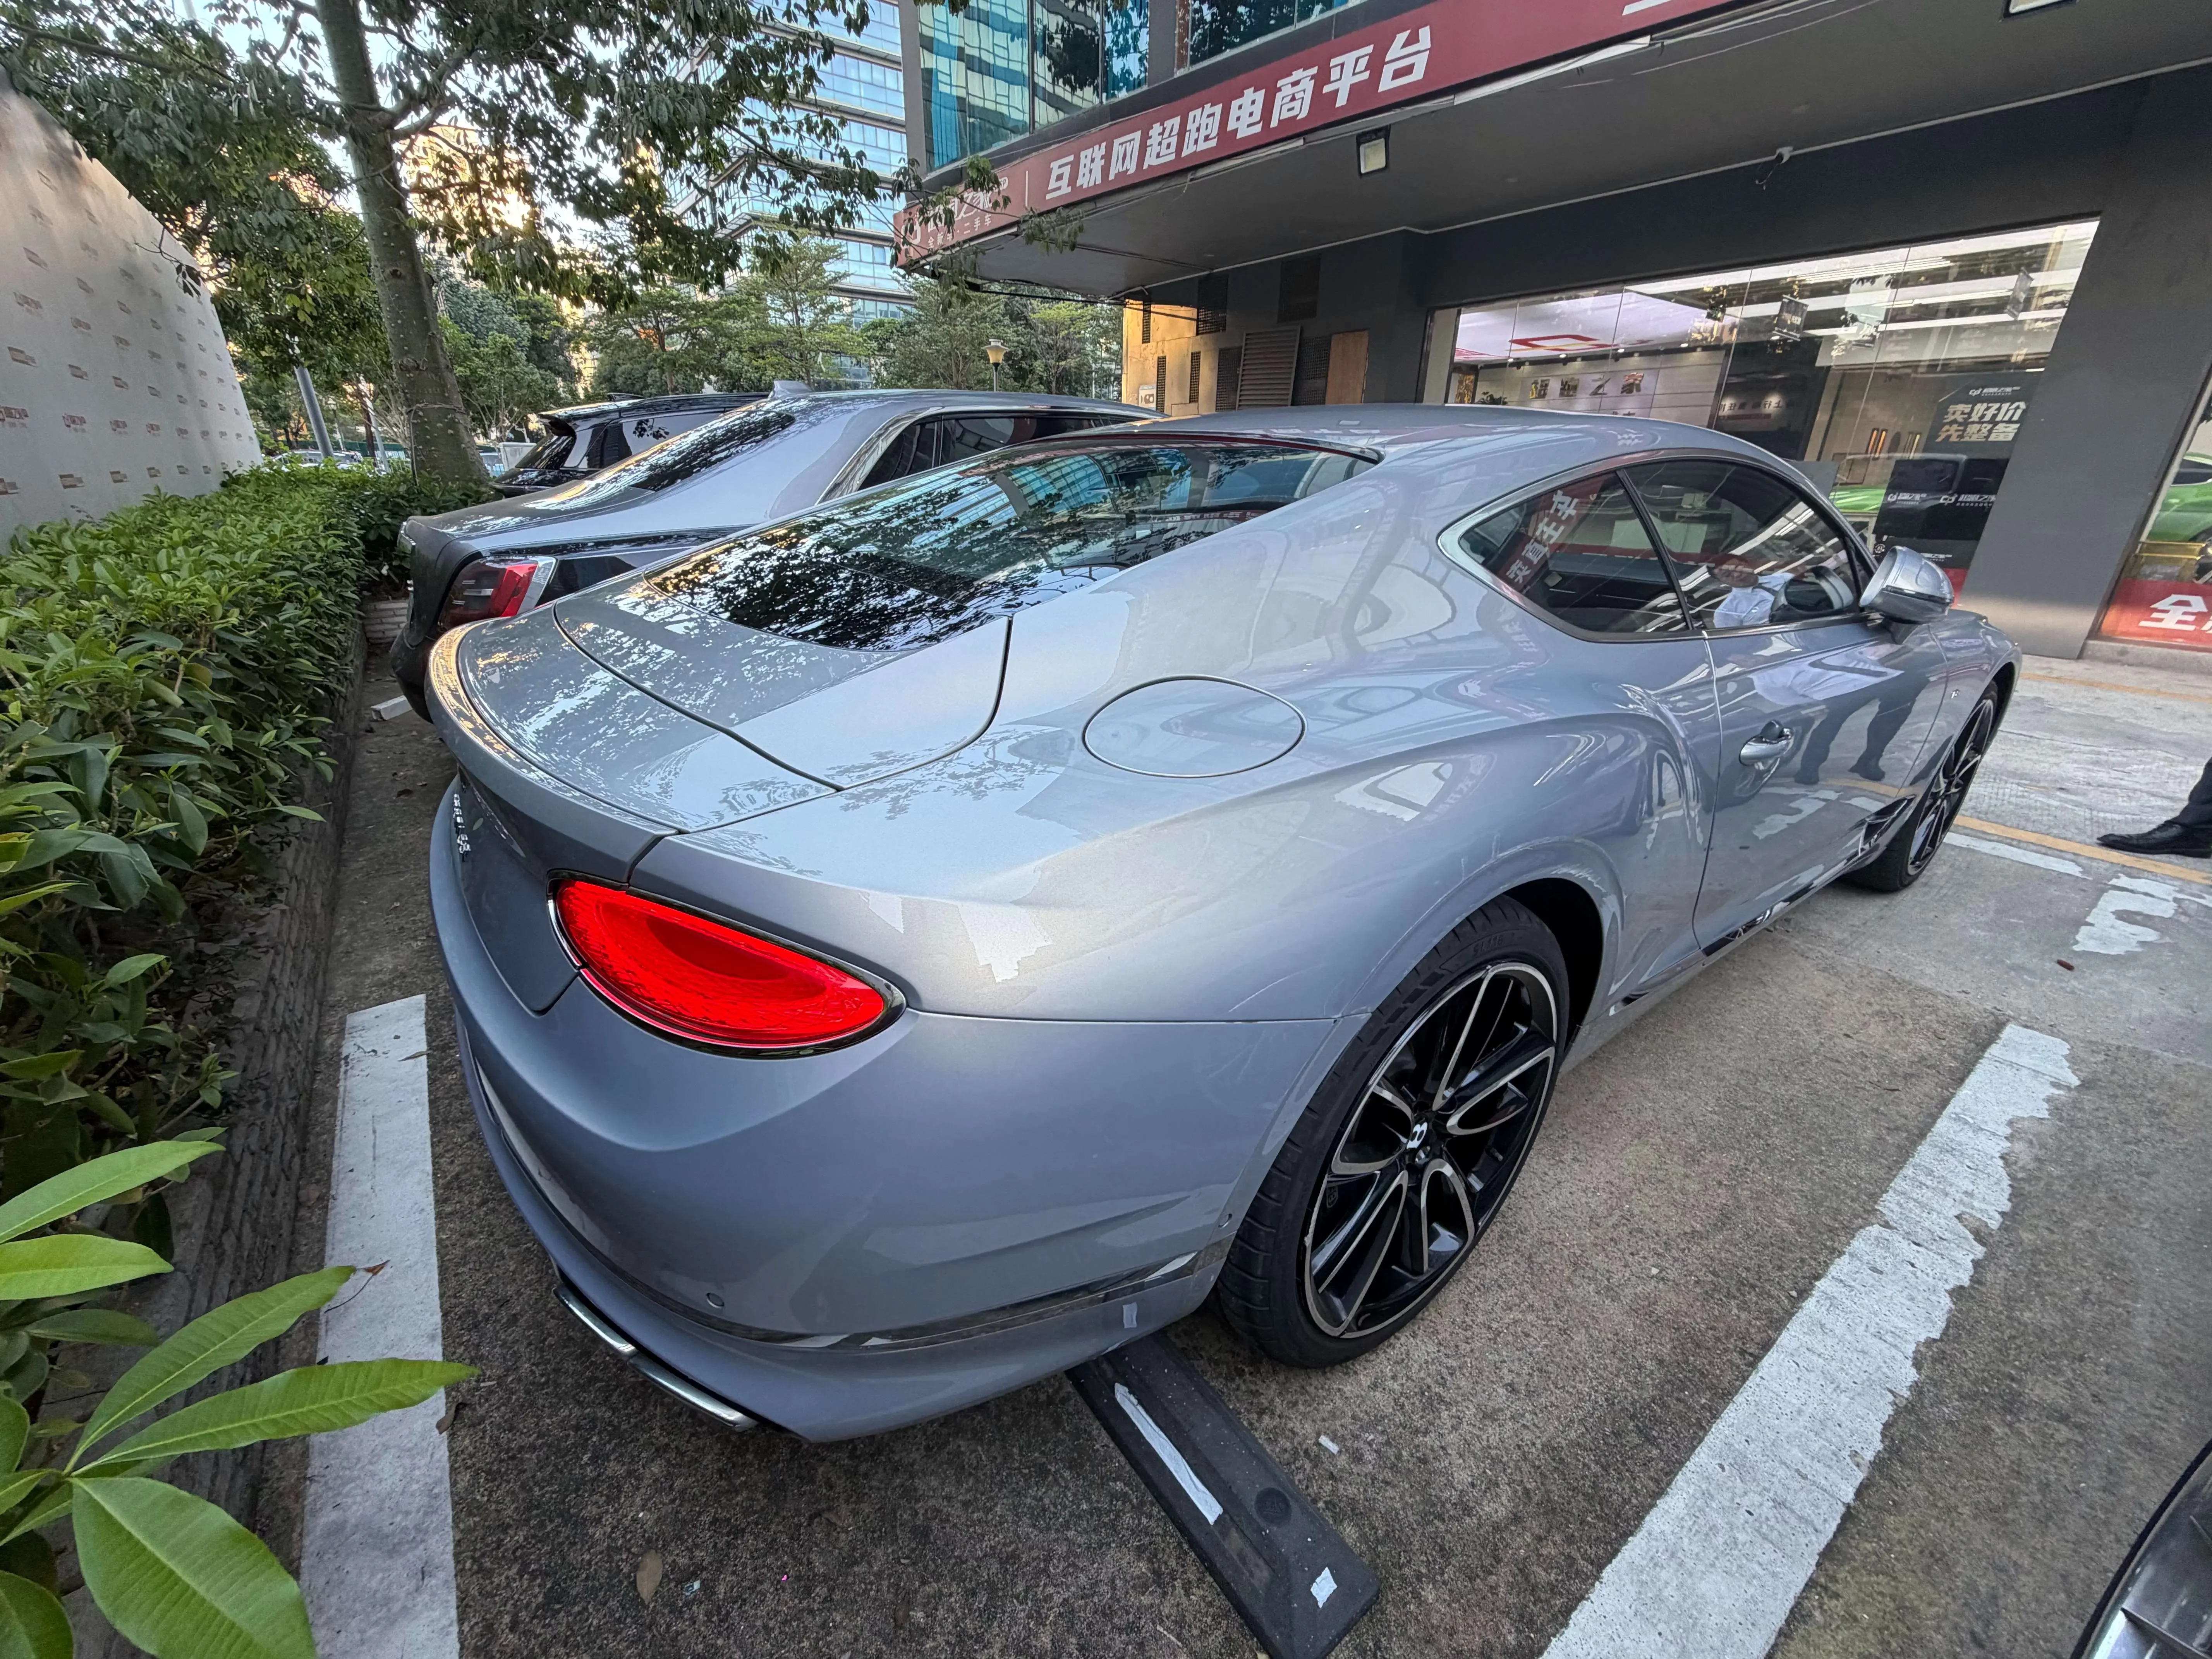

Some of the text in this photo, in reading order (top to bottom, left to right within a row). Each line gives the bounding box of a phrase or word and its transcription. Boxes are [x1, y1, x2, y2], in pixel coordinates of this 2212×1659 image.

[1046, 26, 1431, 200] 互联网超跑电商平台
[1942, 401, 2027, 422] 卖好价
[1935, 423, 2020, 442] 先整备
[2138, 594, 2212, 634] 全
[1407, 1122, 1428, 1150] B
